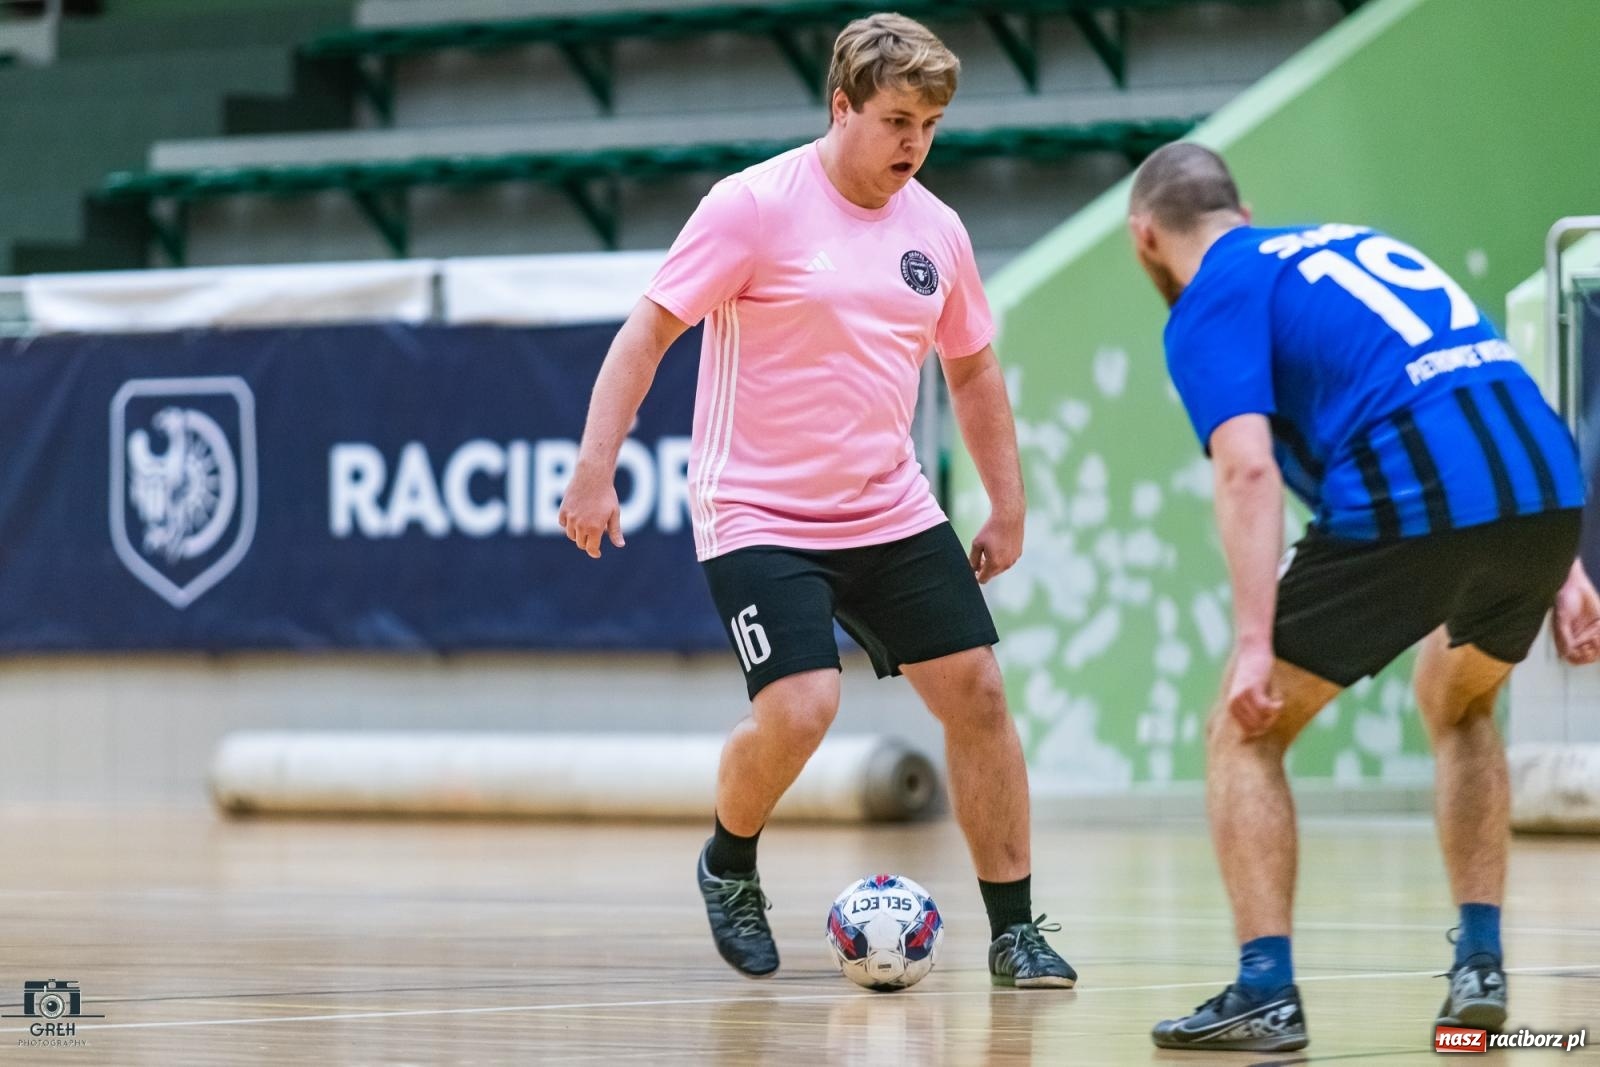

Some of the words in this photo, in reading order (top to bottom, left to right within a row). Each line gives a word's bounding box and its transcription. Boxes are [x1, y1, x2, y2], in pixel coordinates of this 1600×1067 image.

[1298, 236, 1480, 347] 19
[731, 604, 771, 673] 16
[851, 896, 912, 914] SELECT
